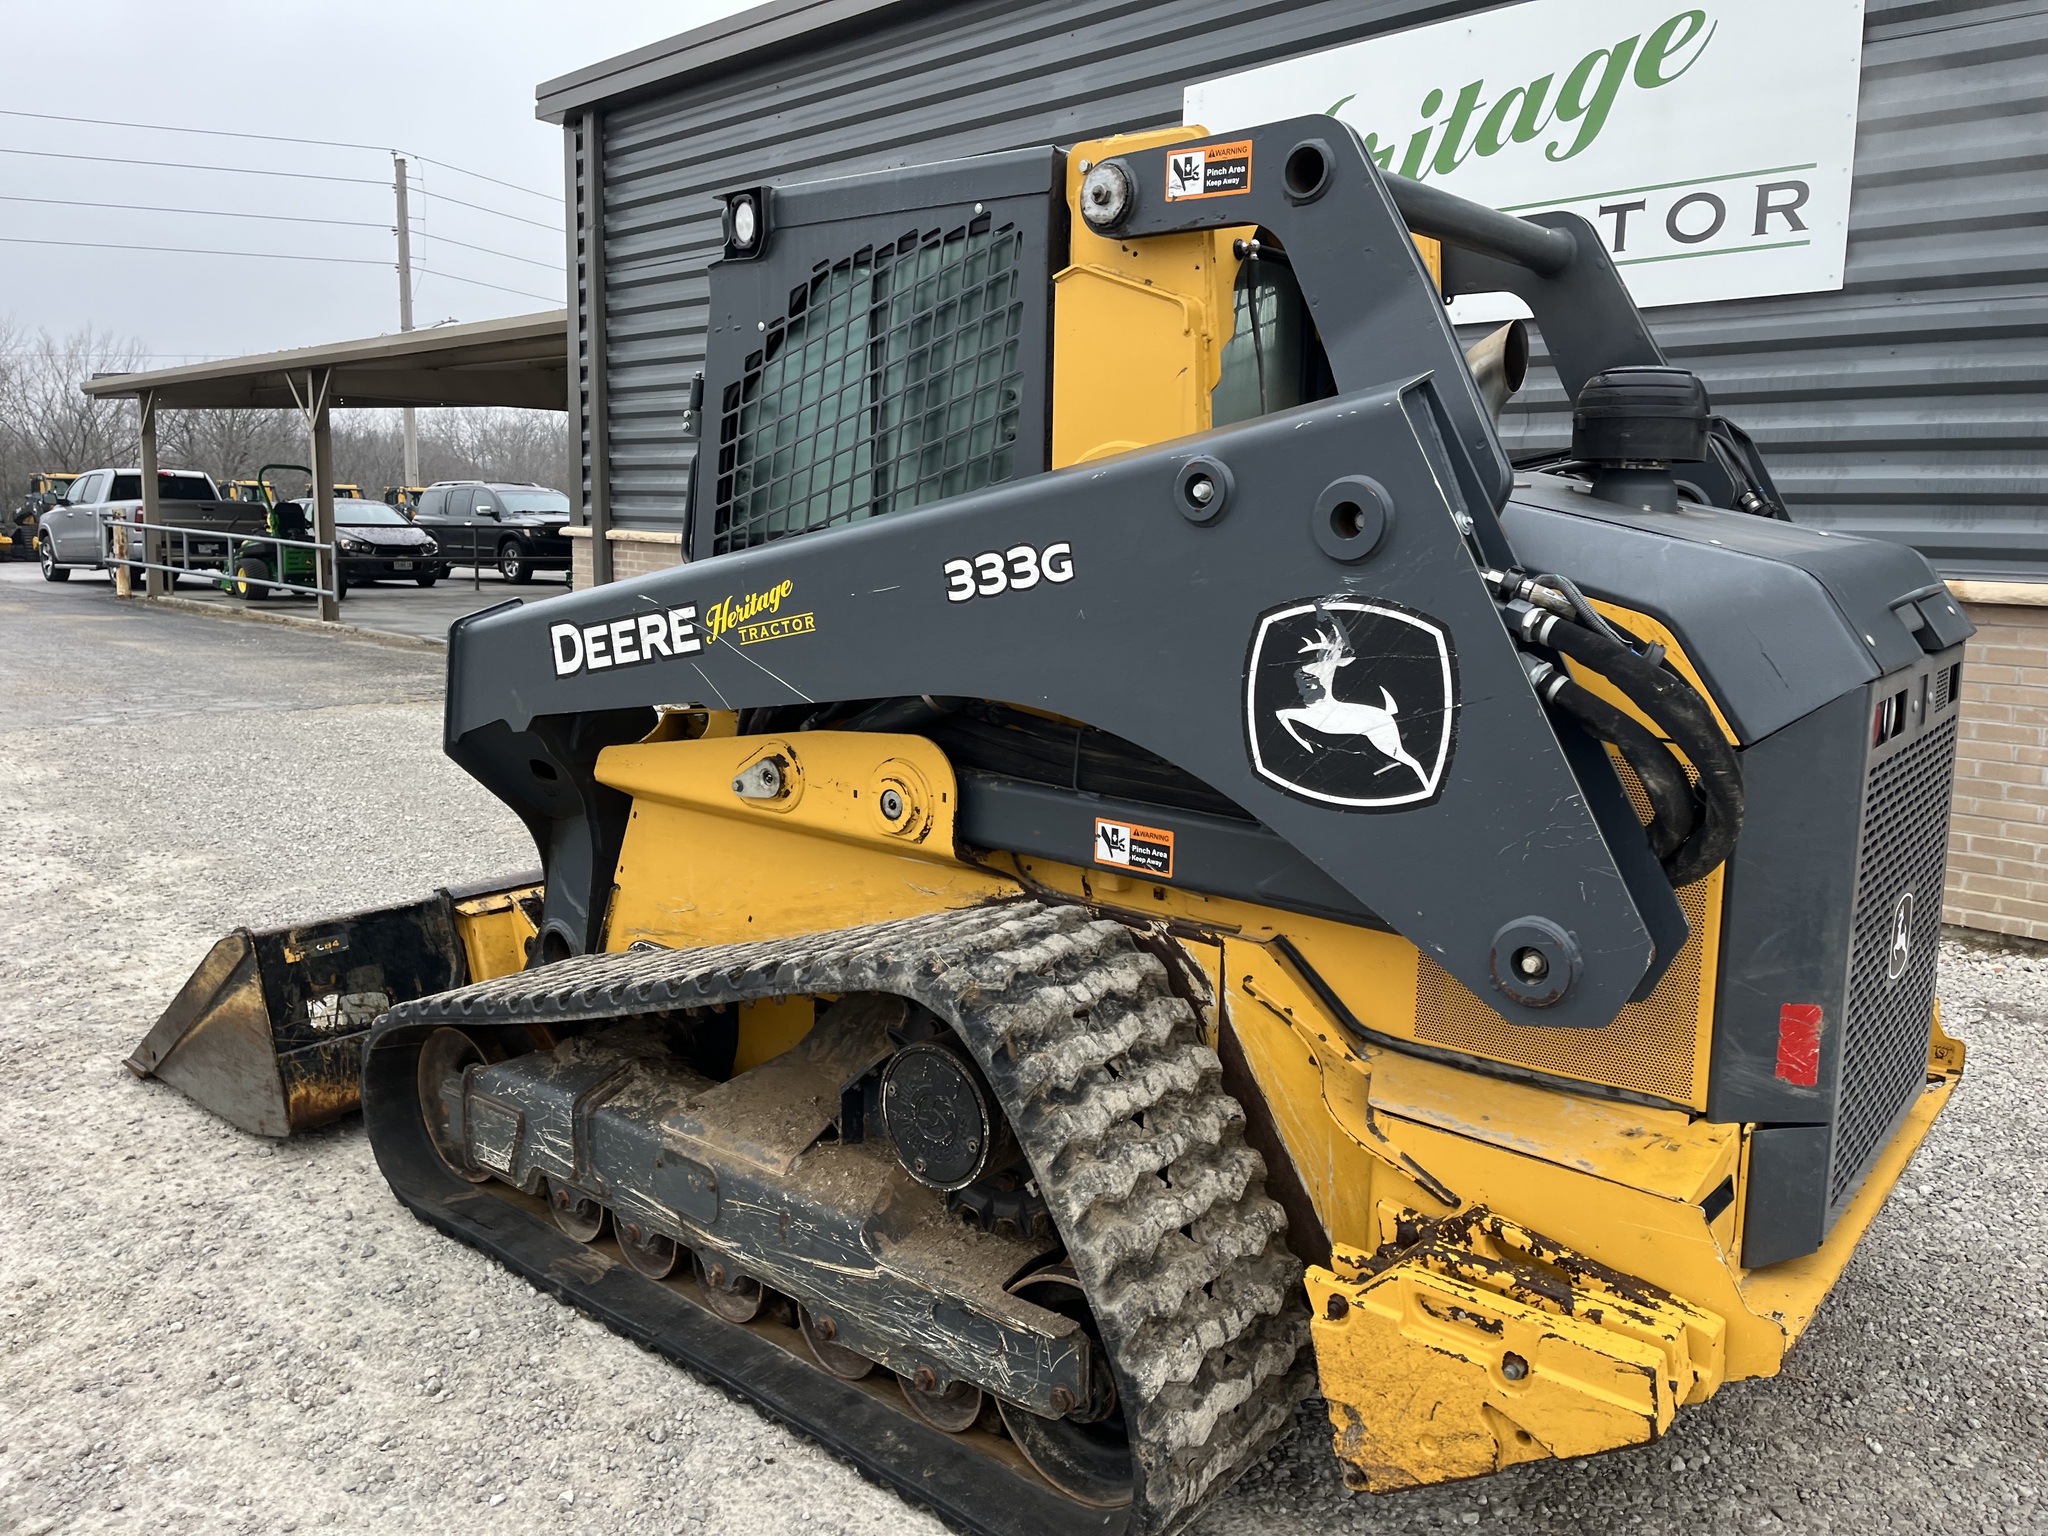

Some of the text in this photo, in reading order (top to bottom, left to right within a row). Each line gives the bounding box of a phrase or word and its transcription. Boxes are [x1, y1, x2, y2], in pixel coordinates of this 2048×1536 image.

[1325, 9, 1718, 182] ritage
[1215, 146, 1248, 157] WARNING
[1206, 165, 1246, 177] Pinch Area
[1206, 177, 1240, 187] Keep Away
[944, 543, 1074, 601] 333G
[706, 579, 793, 644] Heritage
[738, 615, 815, 643] TRACTOR
[550, 606, 701, 675] DEERE
[1140, 831, 1170, 842] WARNING
[1131, 845, 1168, 859] Pinch Area
[1131, 855, 1163, 867] Keep Away
